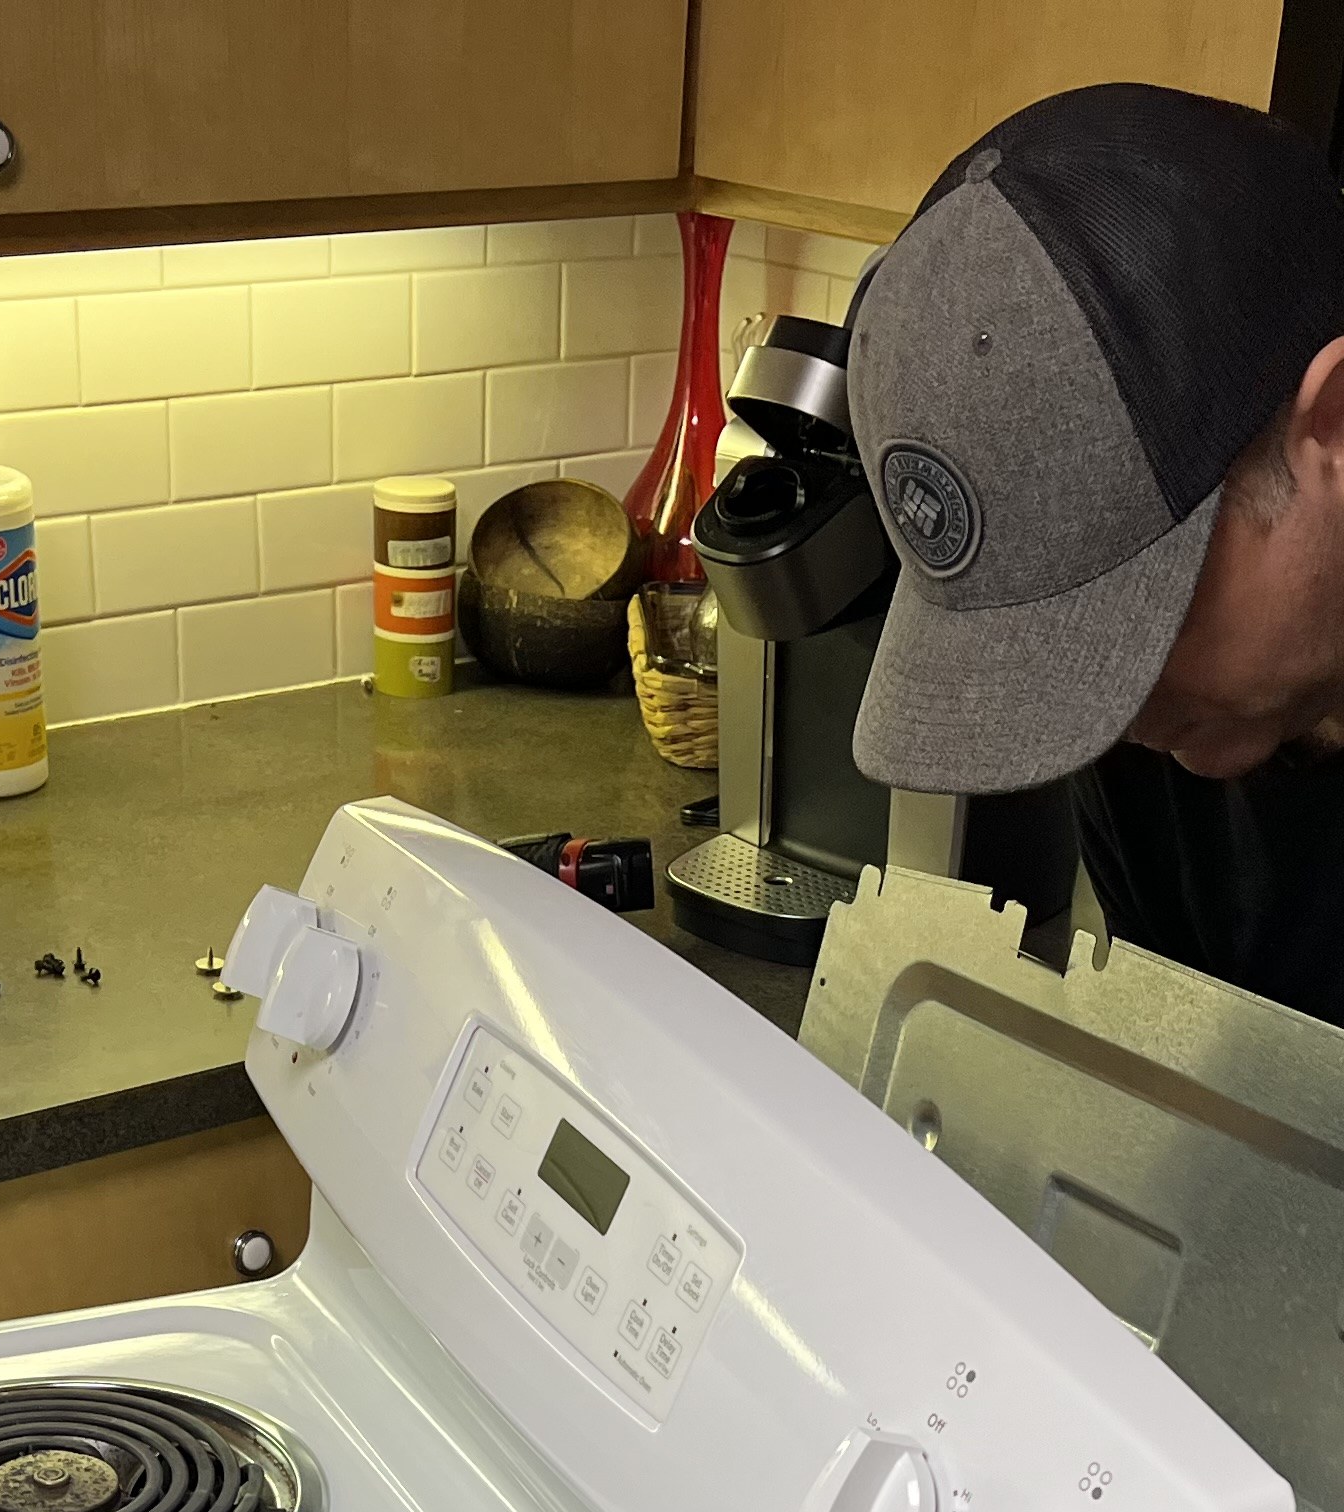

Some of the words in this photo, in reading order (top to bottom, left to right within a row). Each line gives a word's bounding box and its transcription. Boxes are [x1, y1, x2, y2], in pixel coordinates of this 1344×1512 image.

[866, 1412, 878, 1426] Lo
[927, 1413, 946, 1434] Off
[961, 1488, 974, 1503] Hi
